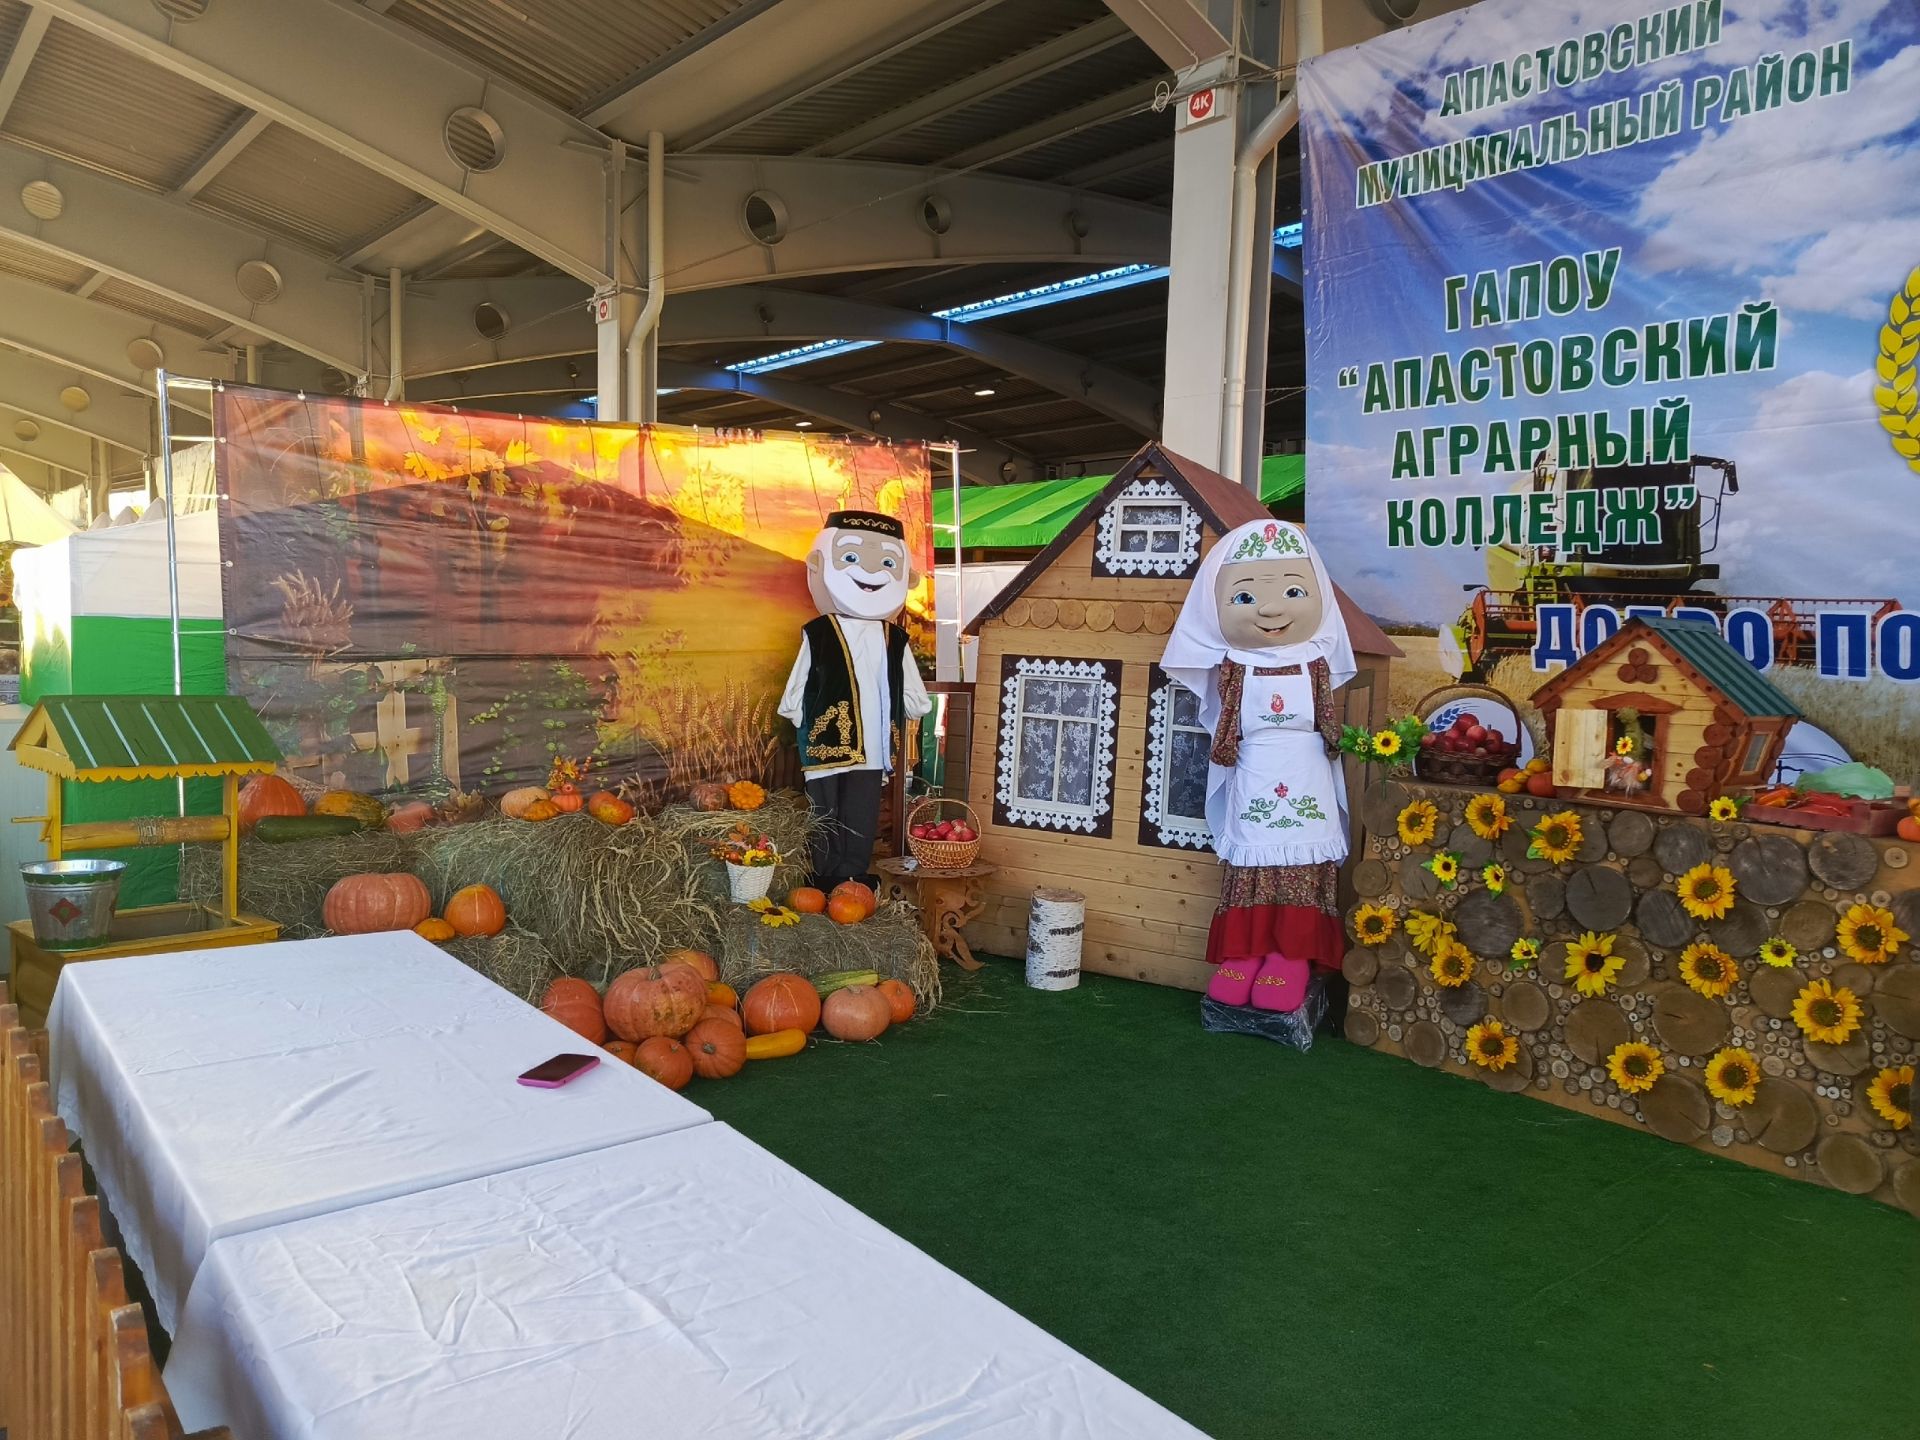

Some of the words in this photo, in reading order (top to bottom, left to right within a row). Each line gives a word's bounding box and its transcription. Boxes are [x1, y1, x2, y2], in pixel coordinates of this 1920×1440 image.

[1355, 82, 1683, 208] МУНИЦИПАЛЬНЫЙ
[1691, 40, 1852, 129] РАЙОН
[1444, 247, 1622, 333] ГАПОУ
[1337, 300, 1779, 416] “АПАСТОВСКИЙ
[1391, 396, 1693, 480] АГРАРНЫЙ
[1386, 484, 1698, 555] КОЛЛЕДЖ”
[1531, 604, 1775, 673] ДОО
